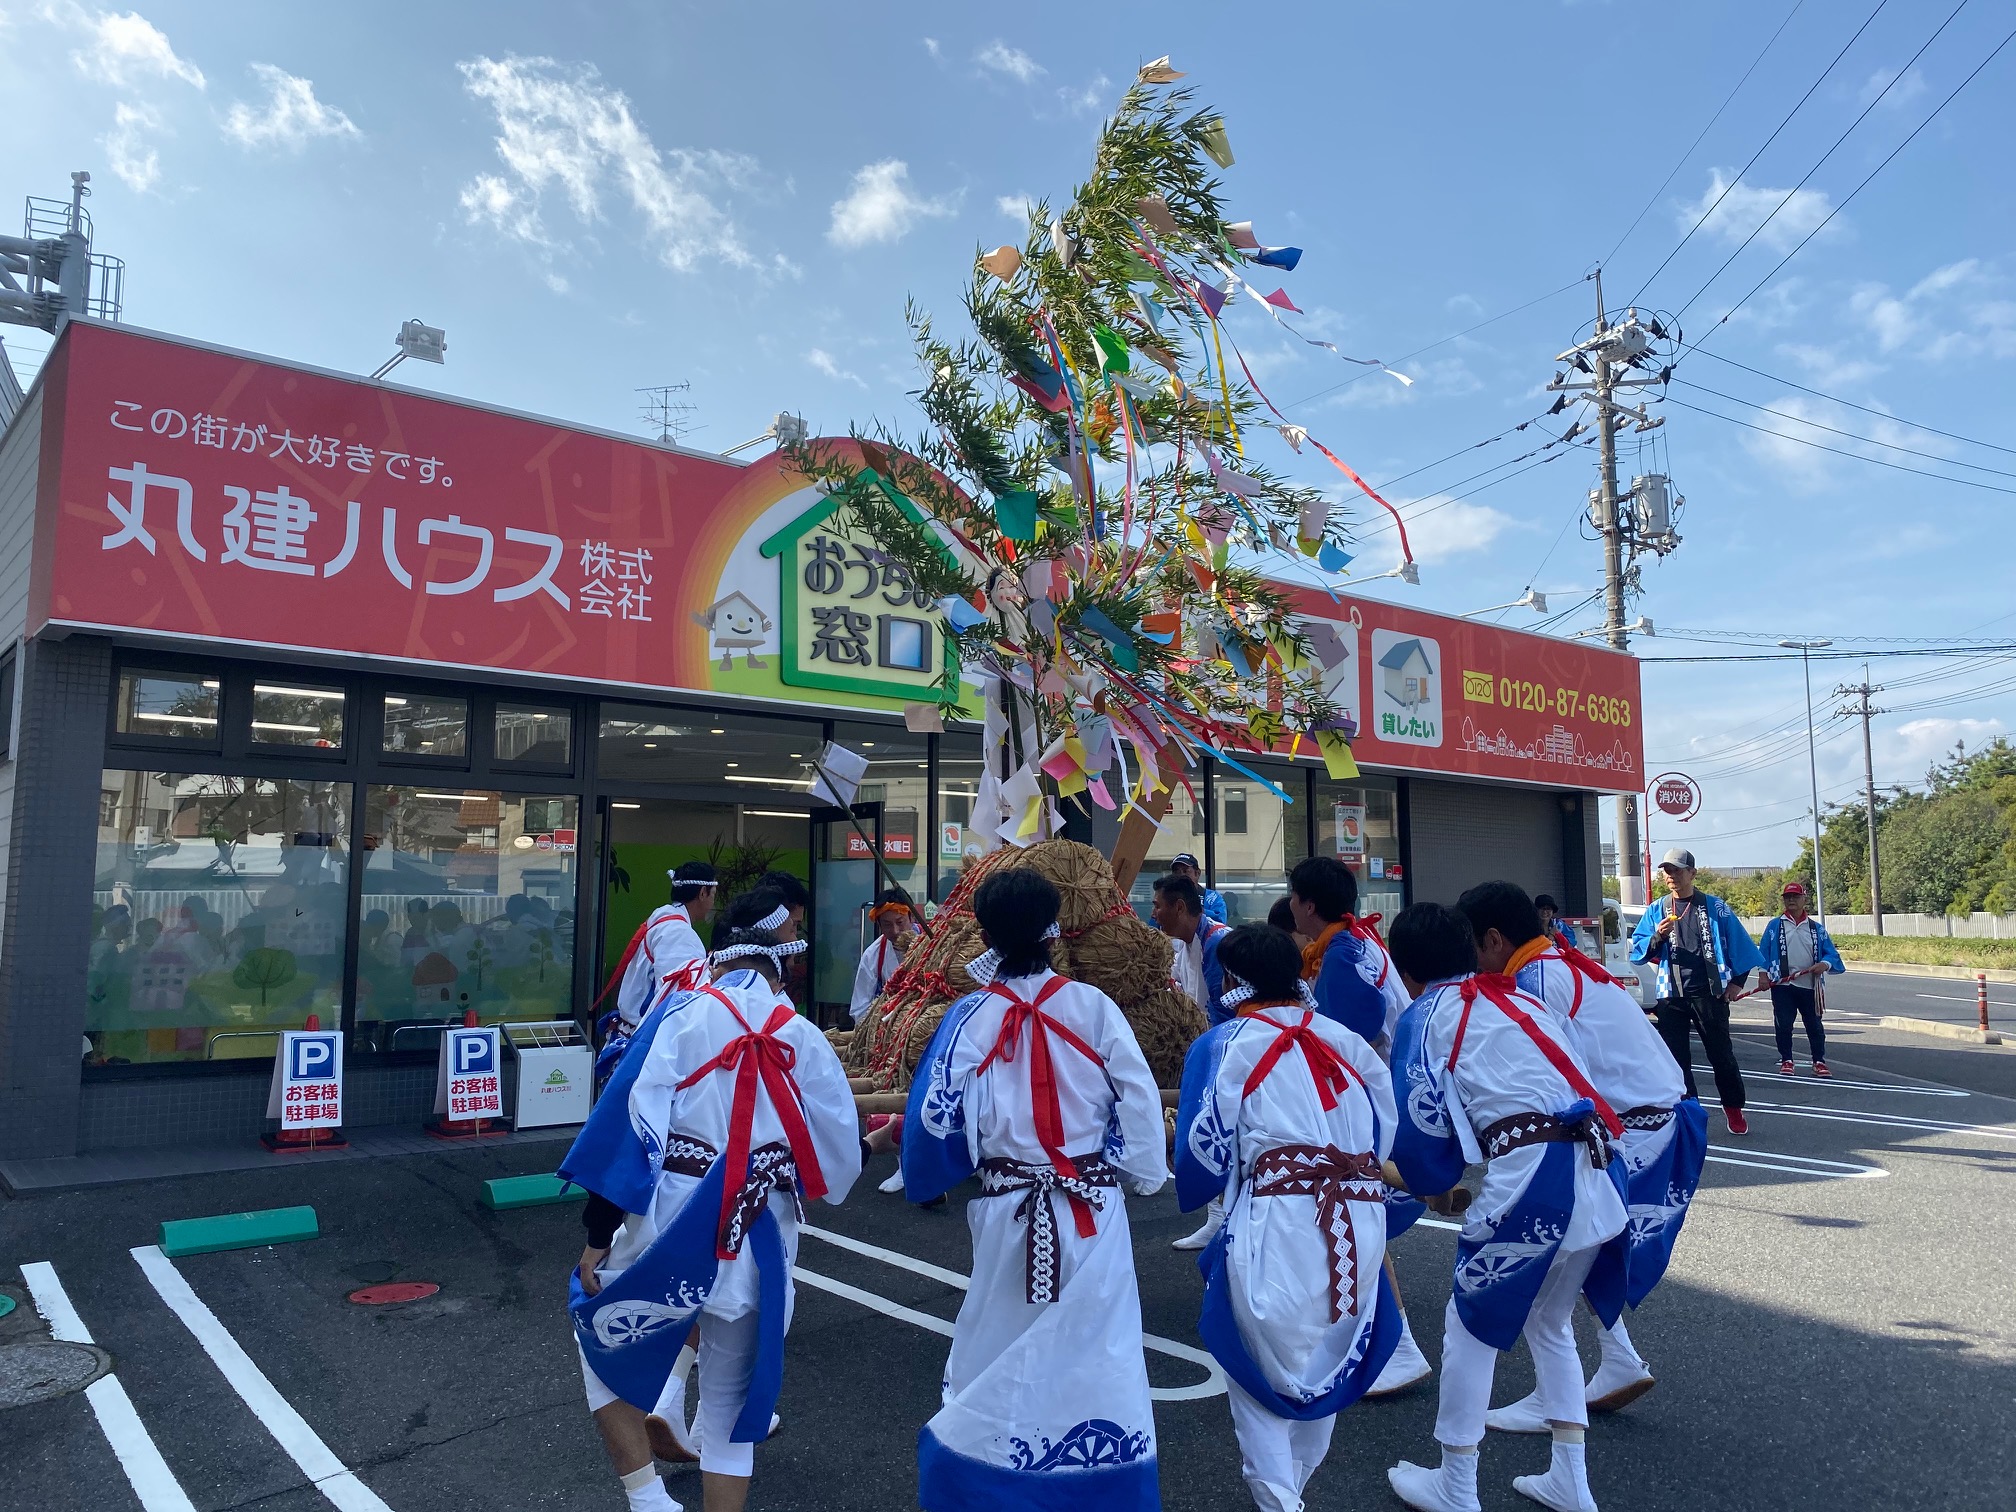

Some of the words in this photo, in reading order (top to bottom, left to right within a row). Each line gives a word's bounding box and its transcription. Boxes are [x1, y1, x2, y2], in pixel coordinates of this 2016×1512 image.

[110, 400, 454, 488] この街が大好きです。
[102, 461, 571, 612] 丸建ハウス
[580, 538, 653, 585] 株式
[580, 578, 652, 621] 会社
[810, 605, 933, 673] 窓口
[1500, 677, 1631, 727] 0120-87-6363
[1382, 712, 1435, 739] 貸したい
[1659, 790, 1690, 805] 消火栓
[298, 1041, 330, 1076] P
[461, 1037, 488, 1070] P
[286, 1083, 339, 1102] お客様
[451, 1077, 498, 1095] お客様
[285, 1103, 339, 1122] 駐車場
[452, 1095, 499, 1114] 駐車場
